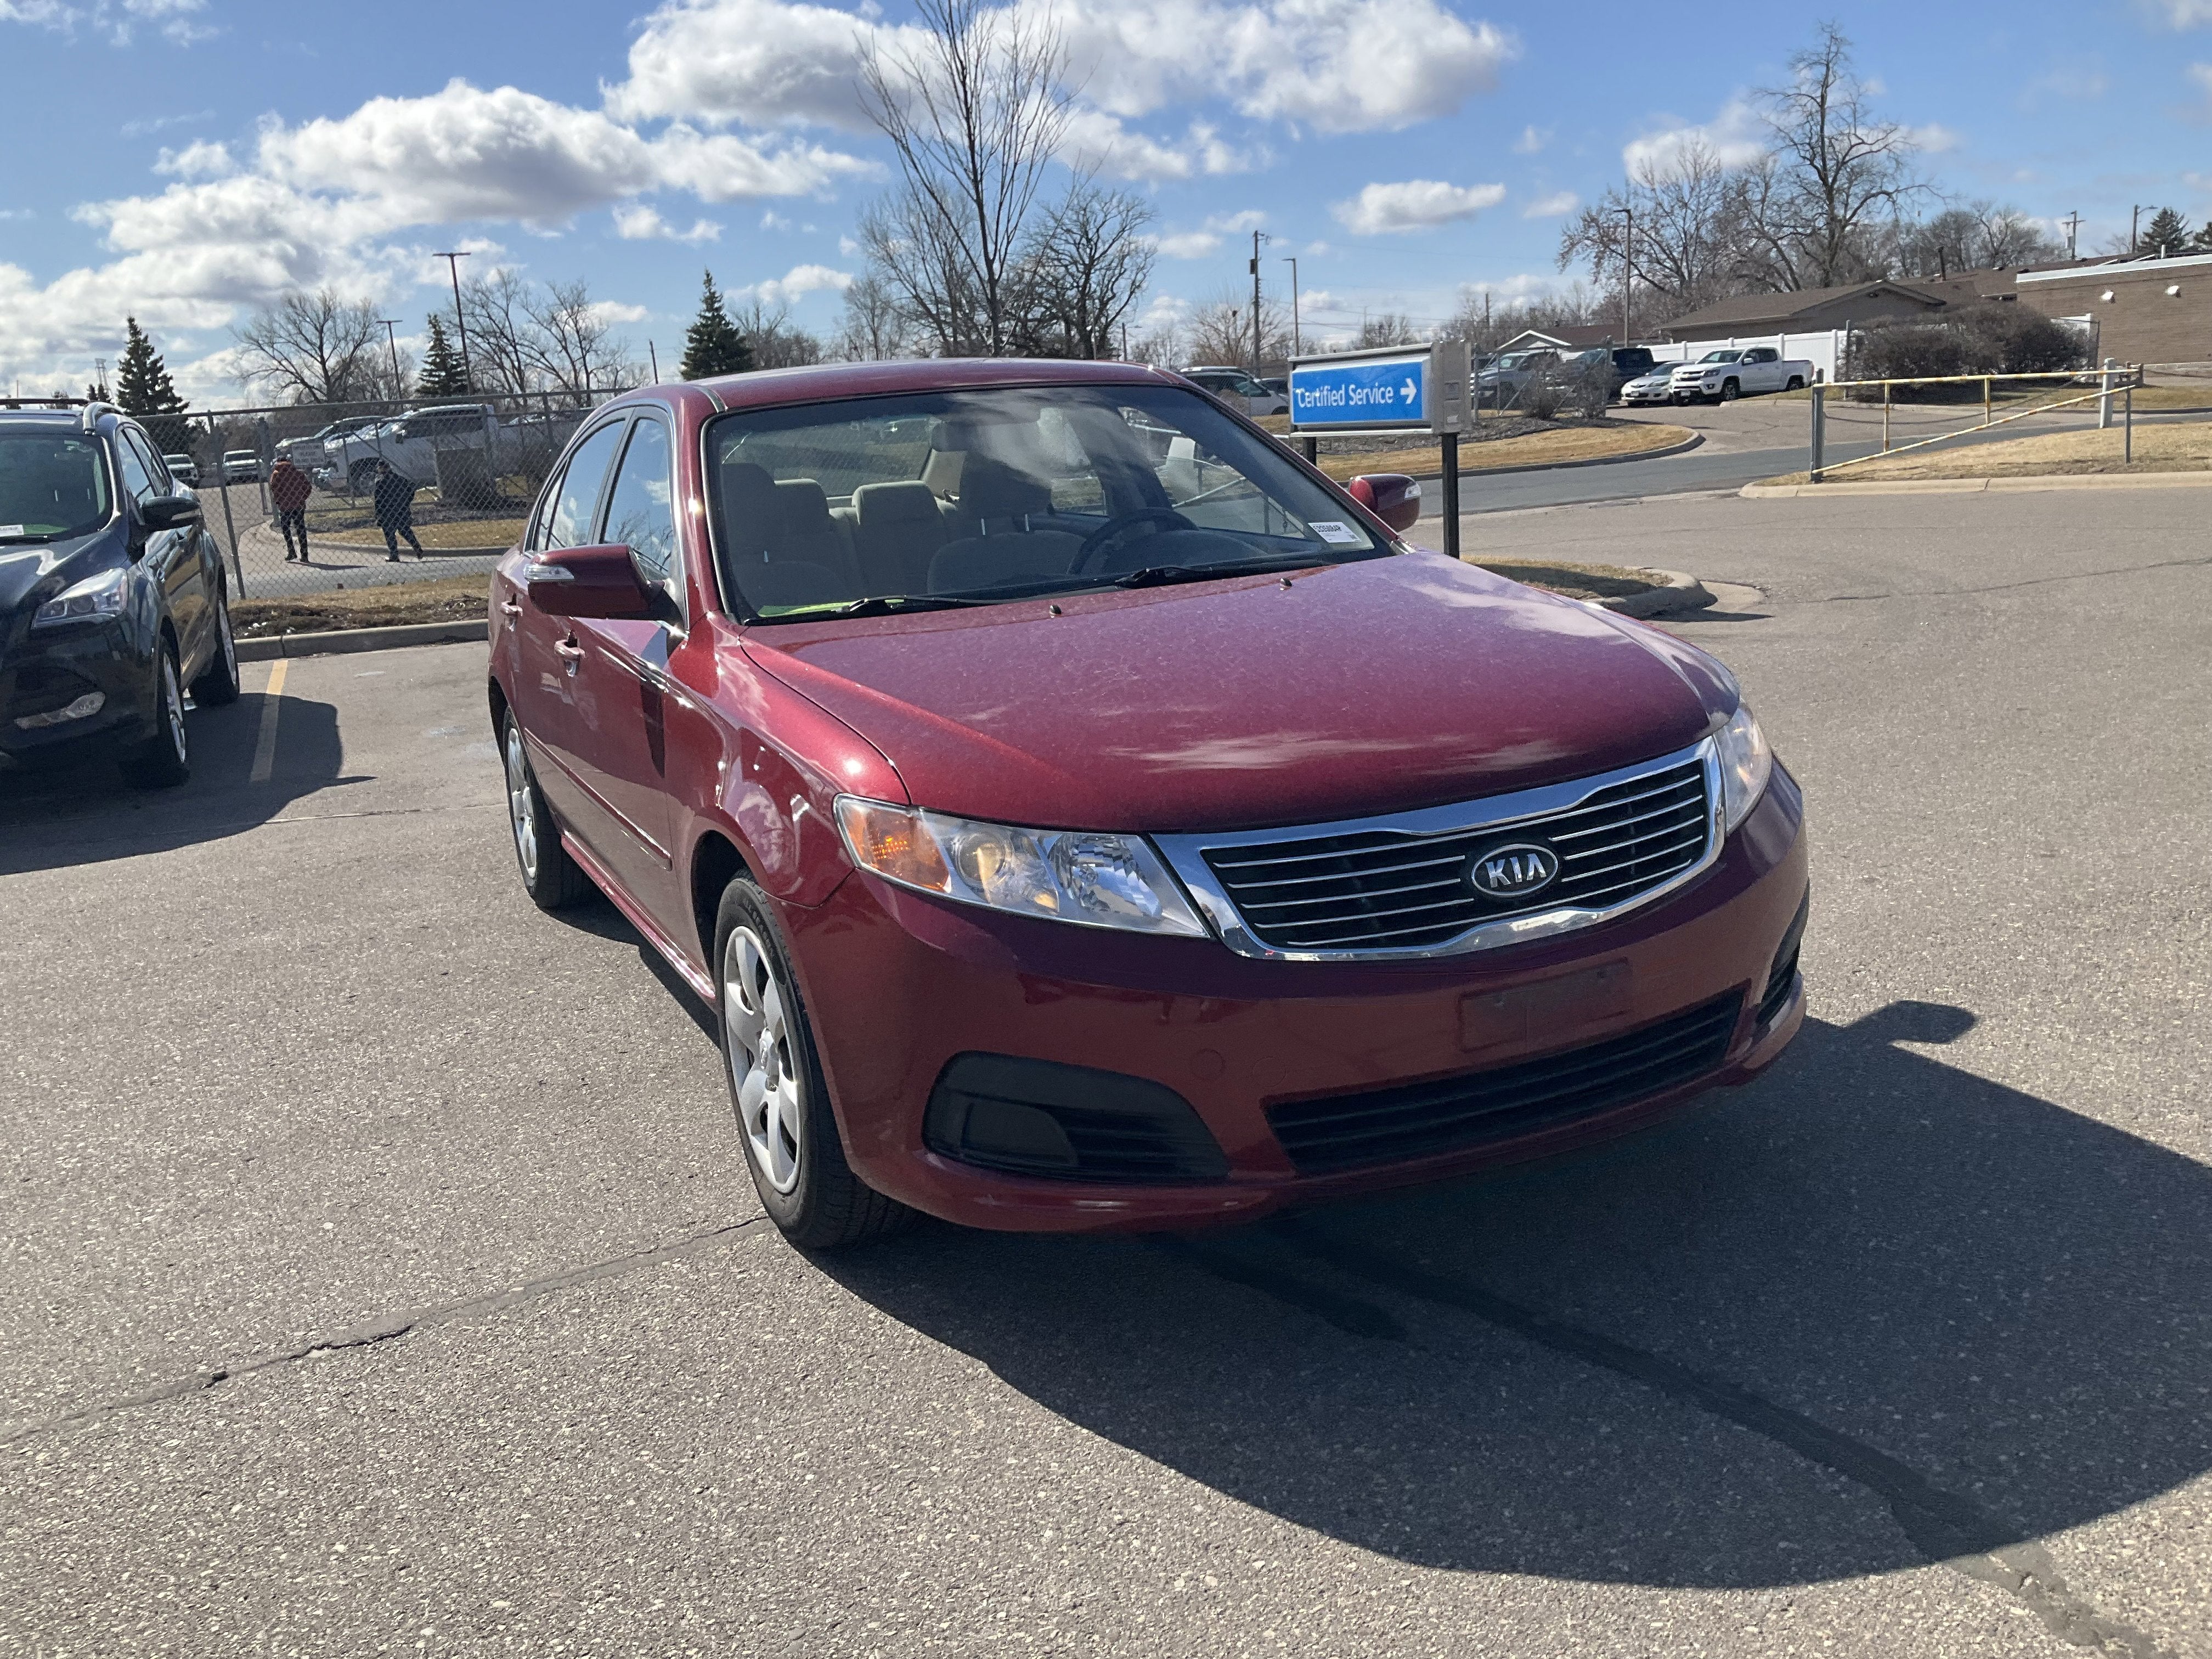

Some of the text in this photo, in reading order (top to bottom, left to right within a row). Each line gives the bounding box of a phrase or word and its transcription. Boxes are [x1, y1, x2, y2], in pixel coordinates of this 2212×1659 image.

[1297, 382, 1394, 408] Certified Service
[1485, 853, 1547, 888] KIA
